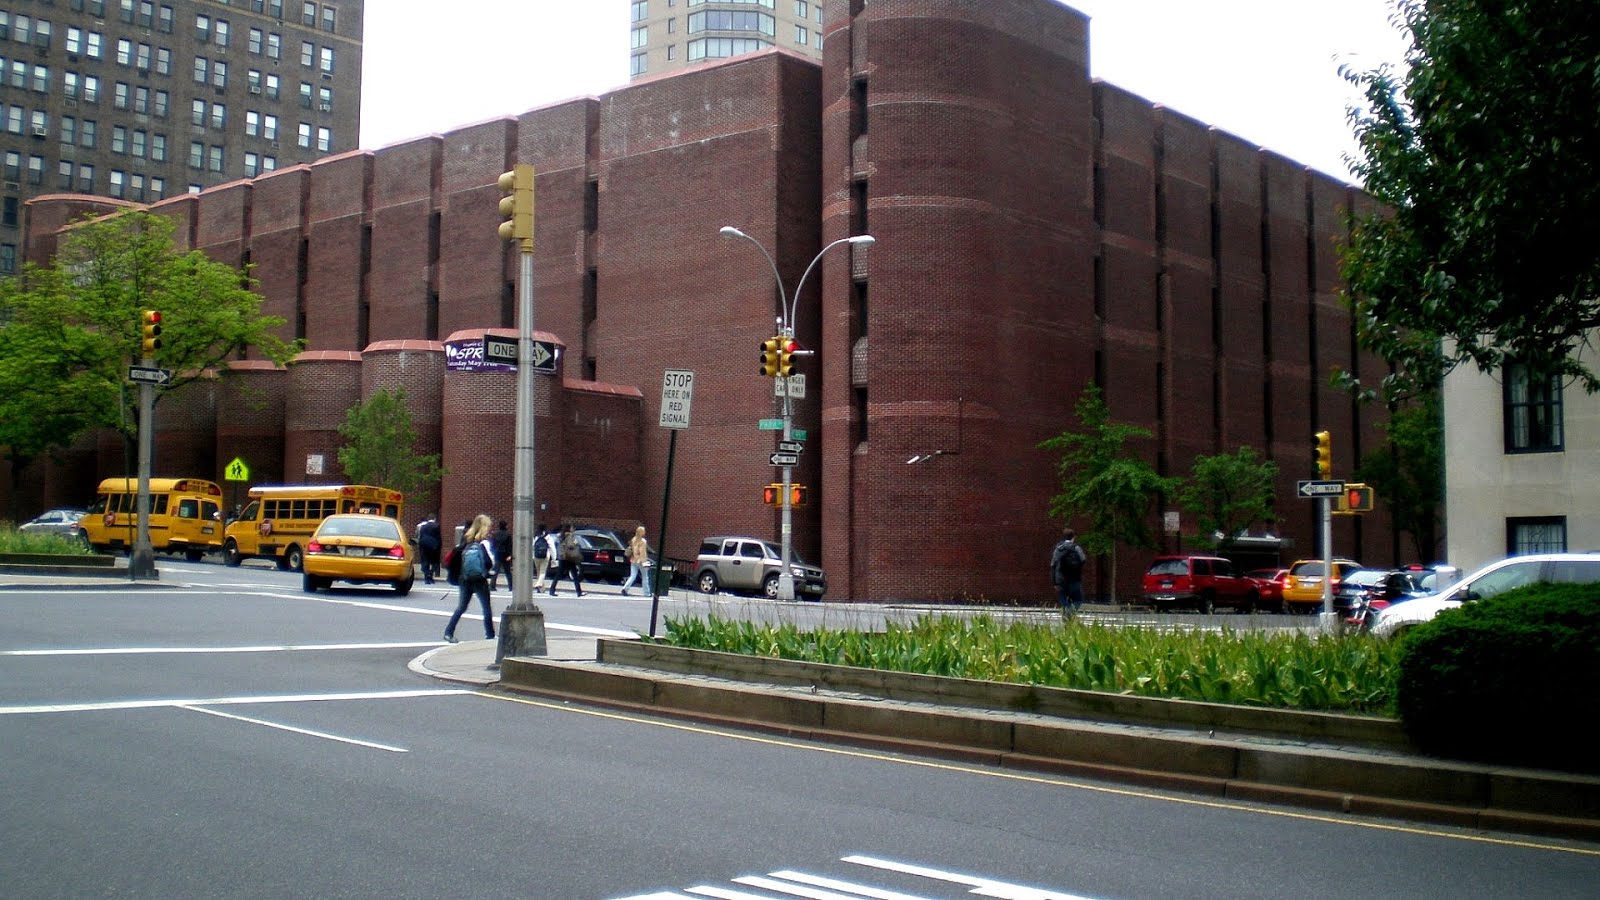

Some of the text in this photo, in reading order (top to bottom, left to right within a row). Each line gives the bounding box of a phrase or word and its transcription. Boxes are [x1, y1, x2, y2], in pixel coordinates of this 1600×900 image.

[493, 344, 515, 357] ONE
[665, 374, 692, 387] STOP
[664, 390, 690, 400] HERE ON
[668, 402, 683, 411] RED
[662, 414, 687, 424] SIGNAL
